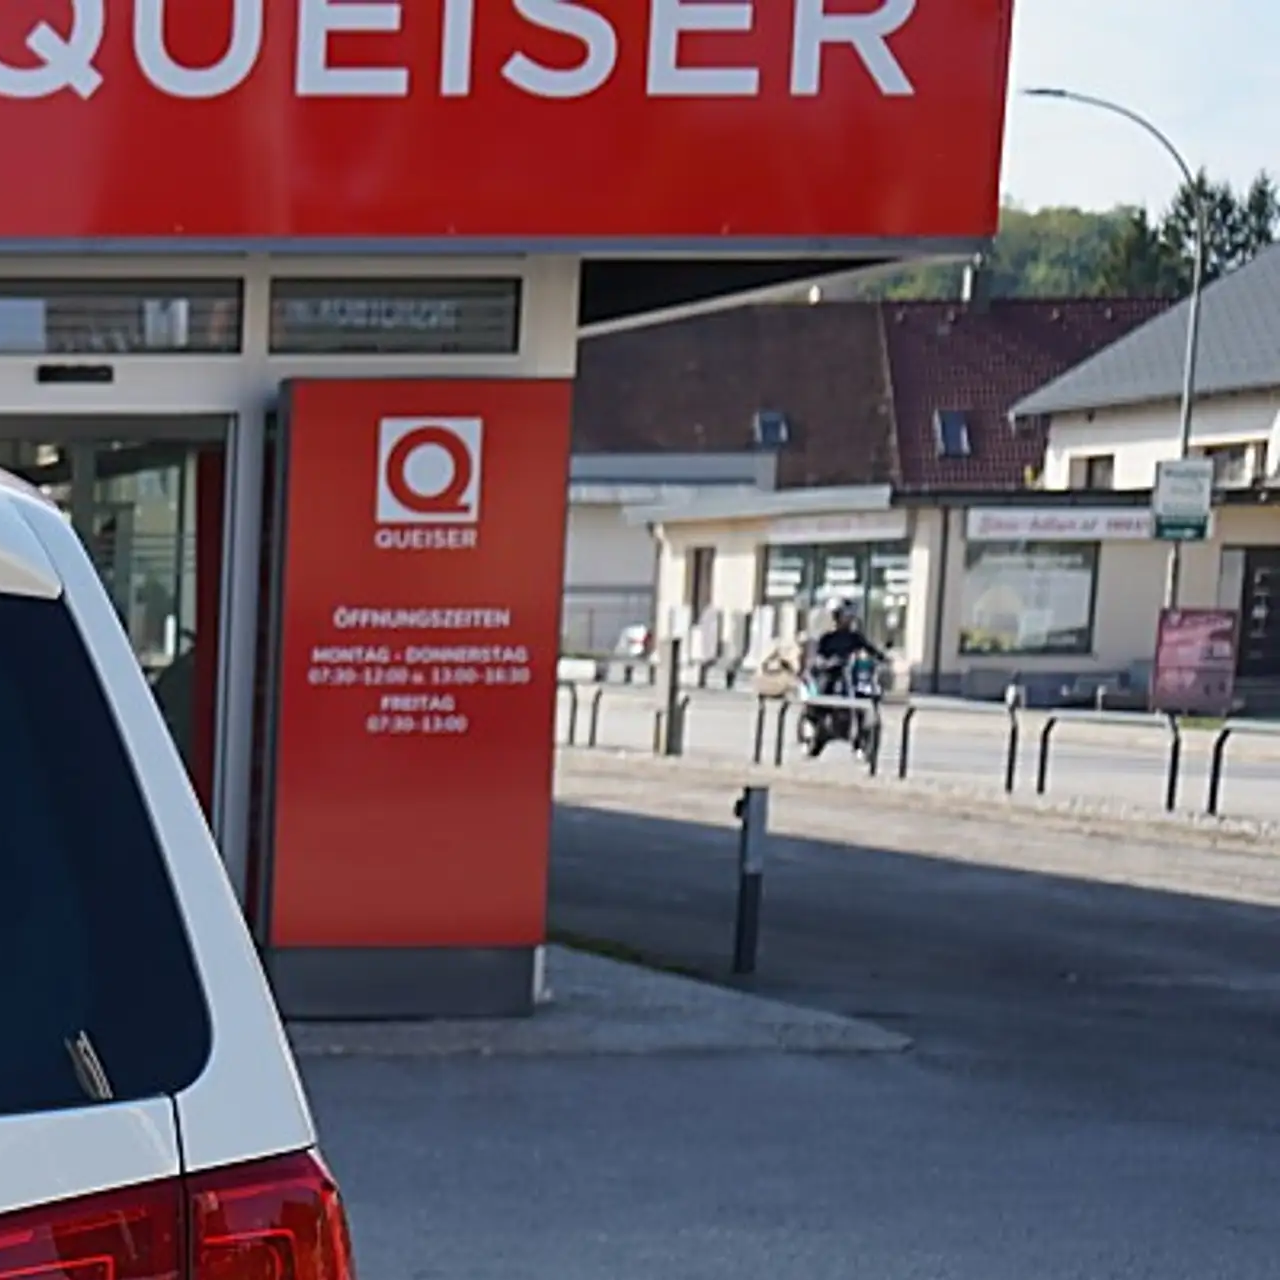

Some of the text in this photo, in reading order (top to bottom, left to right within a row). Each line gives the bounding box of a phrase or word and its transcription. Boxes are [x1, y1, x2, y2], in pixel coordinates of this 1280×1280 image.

[375, 528, 478, 549] QUEISER
[334, 605, 510, 628] ÖFFNUNGSZEITEN
[312, 646, 390, 663] MONTAG
[405, 646, 529, 663] DONNERSTAG
[381, 694, 455, 711] FREITAG
